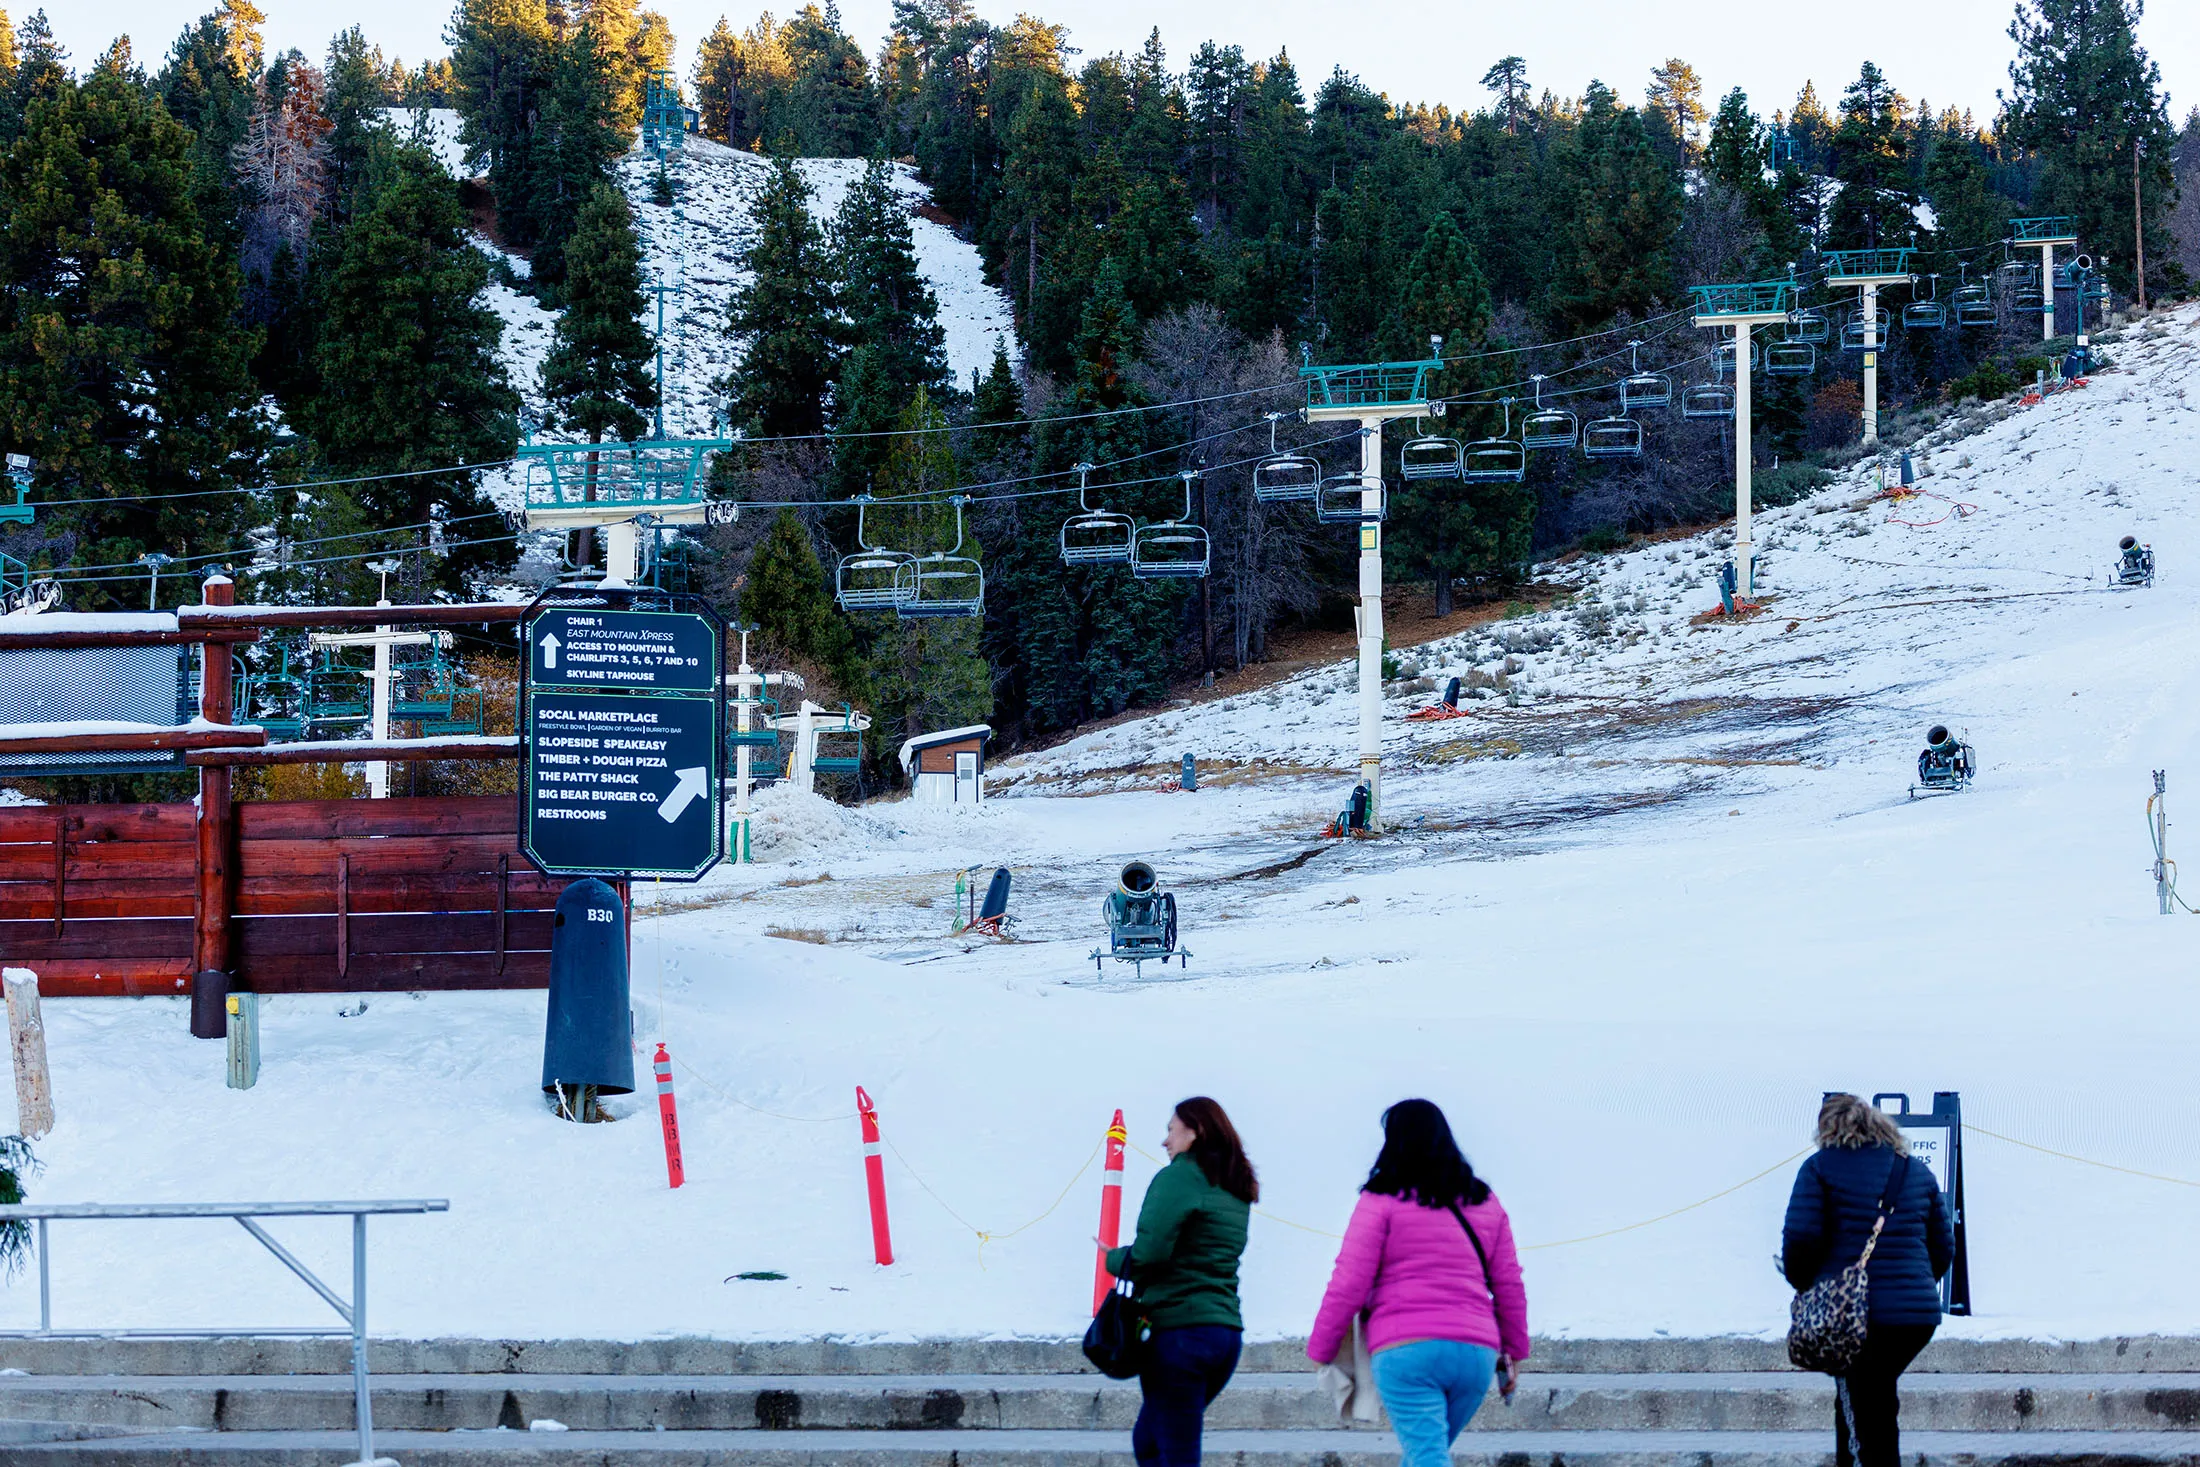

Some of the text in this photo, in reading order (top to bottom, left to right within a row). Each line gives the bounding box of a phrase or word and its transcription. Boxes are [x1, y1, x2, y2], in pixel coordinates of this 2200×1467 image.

[565, 453, 571, 462] 3
[567, 617, 602, 626] CHAIR 1
[567, 629, 589, 637] EAST
[591, 630, 638, 639] MOUNTAIN
[567, 642, 602, 650] ACCESS
[604, 643, 616, 651] TO
[618, 644, 666, 653] MOUNTAIN
[567, 653, 619, 662] CHAIRLIFTS
[621, 655, 629, 664] 3,
[632, 656, 641, 665] 5,
[644, 656, 653, 665] 6,
[664, 657, 683, 665] AND
[686, 658, 698, 666] 10
[567, 670, 654, 680] SKYLINE TAPHOUSE
[539, 710, 658, 723] SOCAL MARKETPLACE
[539, 737, 667, 750] SLOPESIDE SPEAKEASY
[538, 754, 580, 764] TIMBER
[593, 756, 633, 766] DOUGH
[636, 757, 667, 767] PIZZA
[538, 772, 638, 784] THE PATTY SHACK
[539, 789, 658, 802] BIG BEAR BURGER CO.
[538, 809, 606, 820] RESTROOMS
[588, 909, 613, 922] B30
[1913, 1141, 1937, 1150] FFIC
